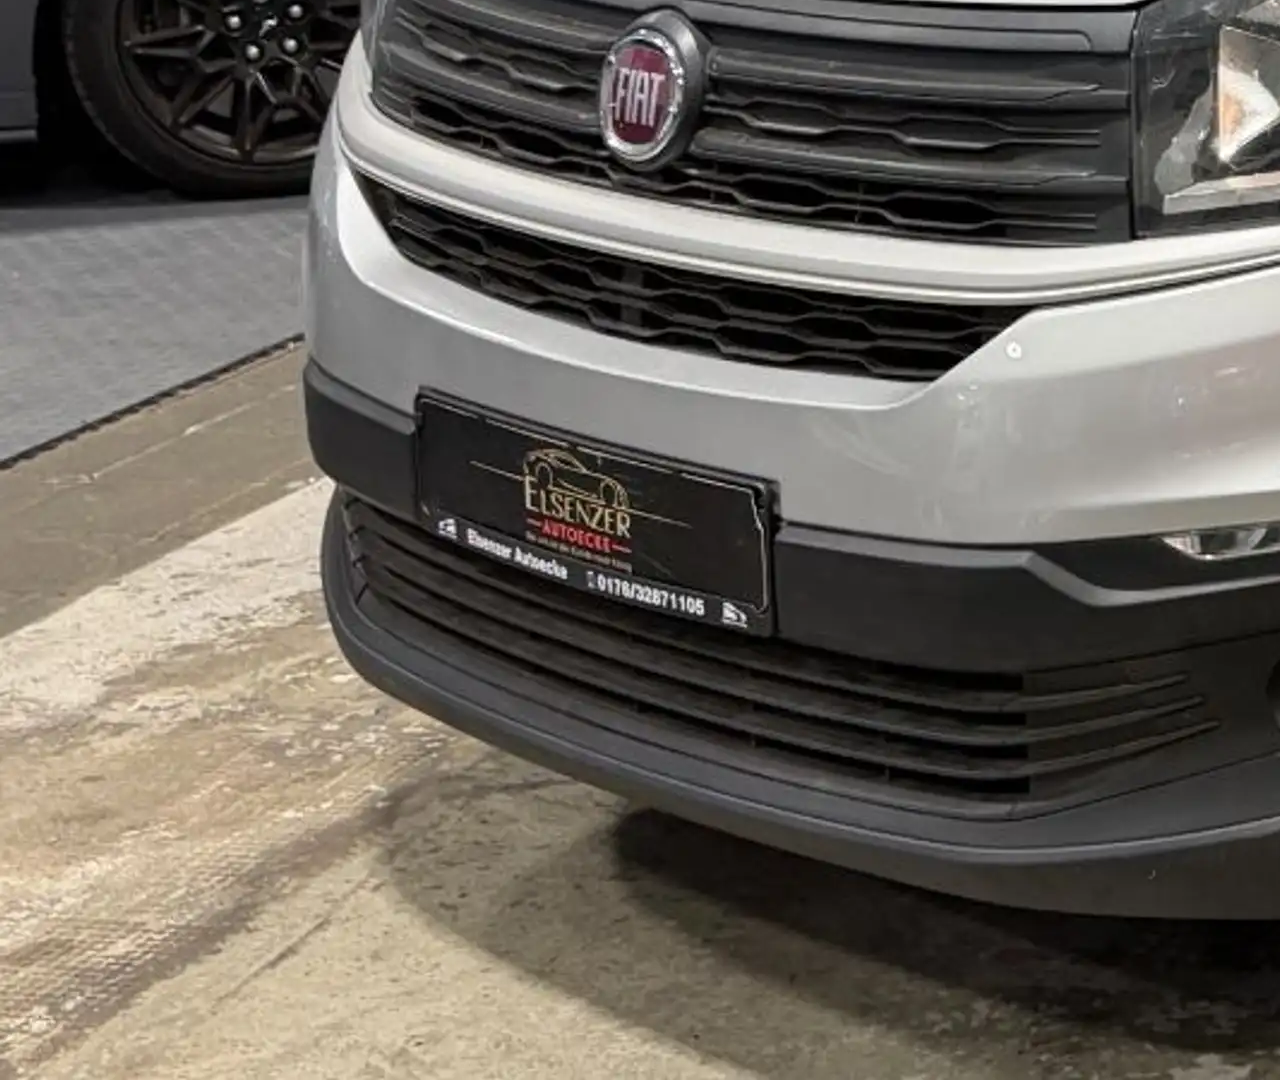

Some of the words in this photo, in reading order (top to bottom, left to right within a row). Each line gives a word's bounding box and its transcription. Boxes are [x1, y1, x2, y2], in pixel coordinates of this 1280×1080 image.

[615, 67, 666, 126] FIAT
[525, 476, 631, 538] ELSENZER
[542, 519, 611, 553] AUTOECKE
